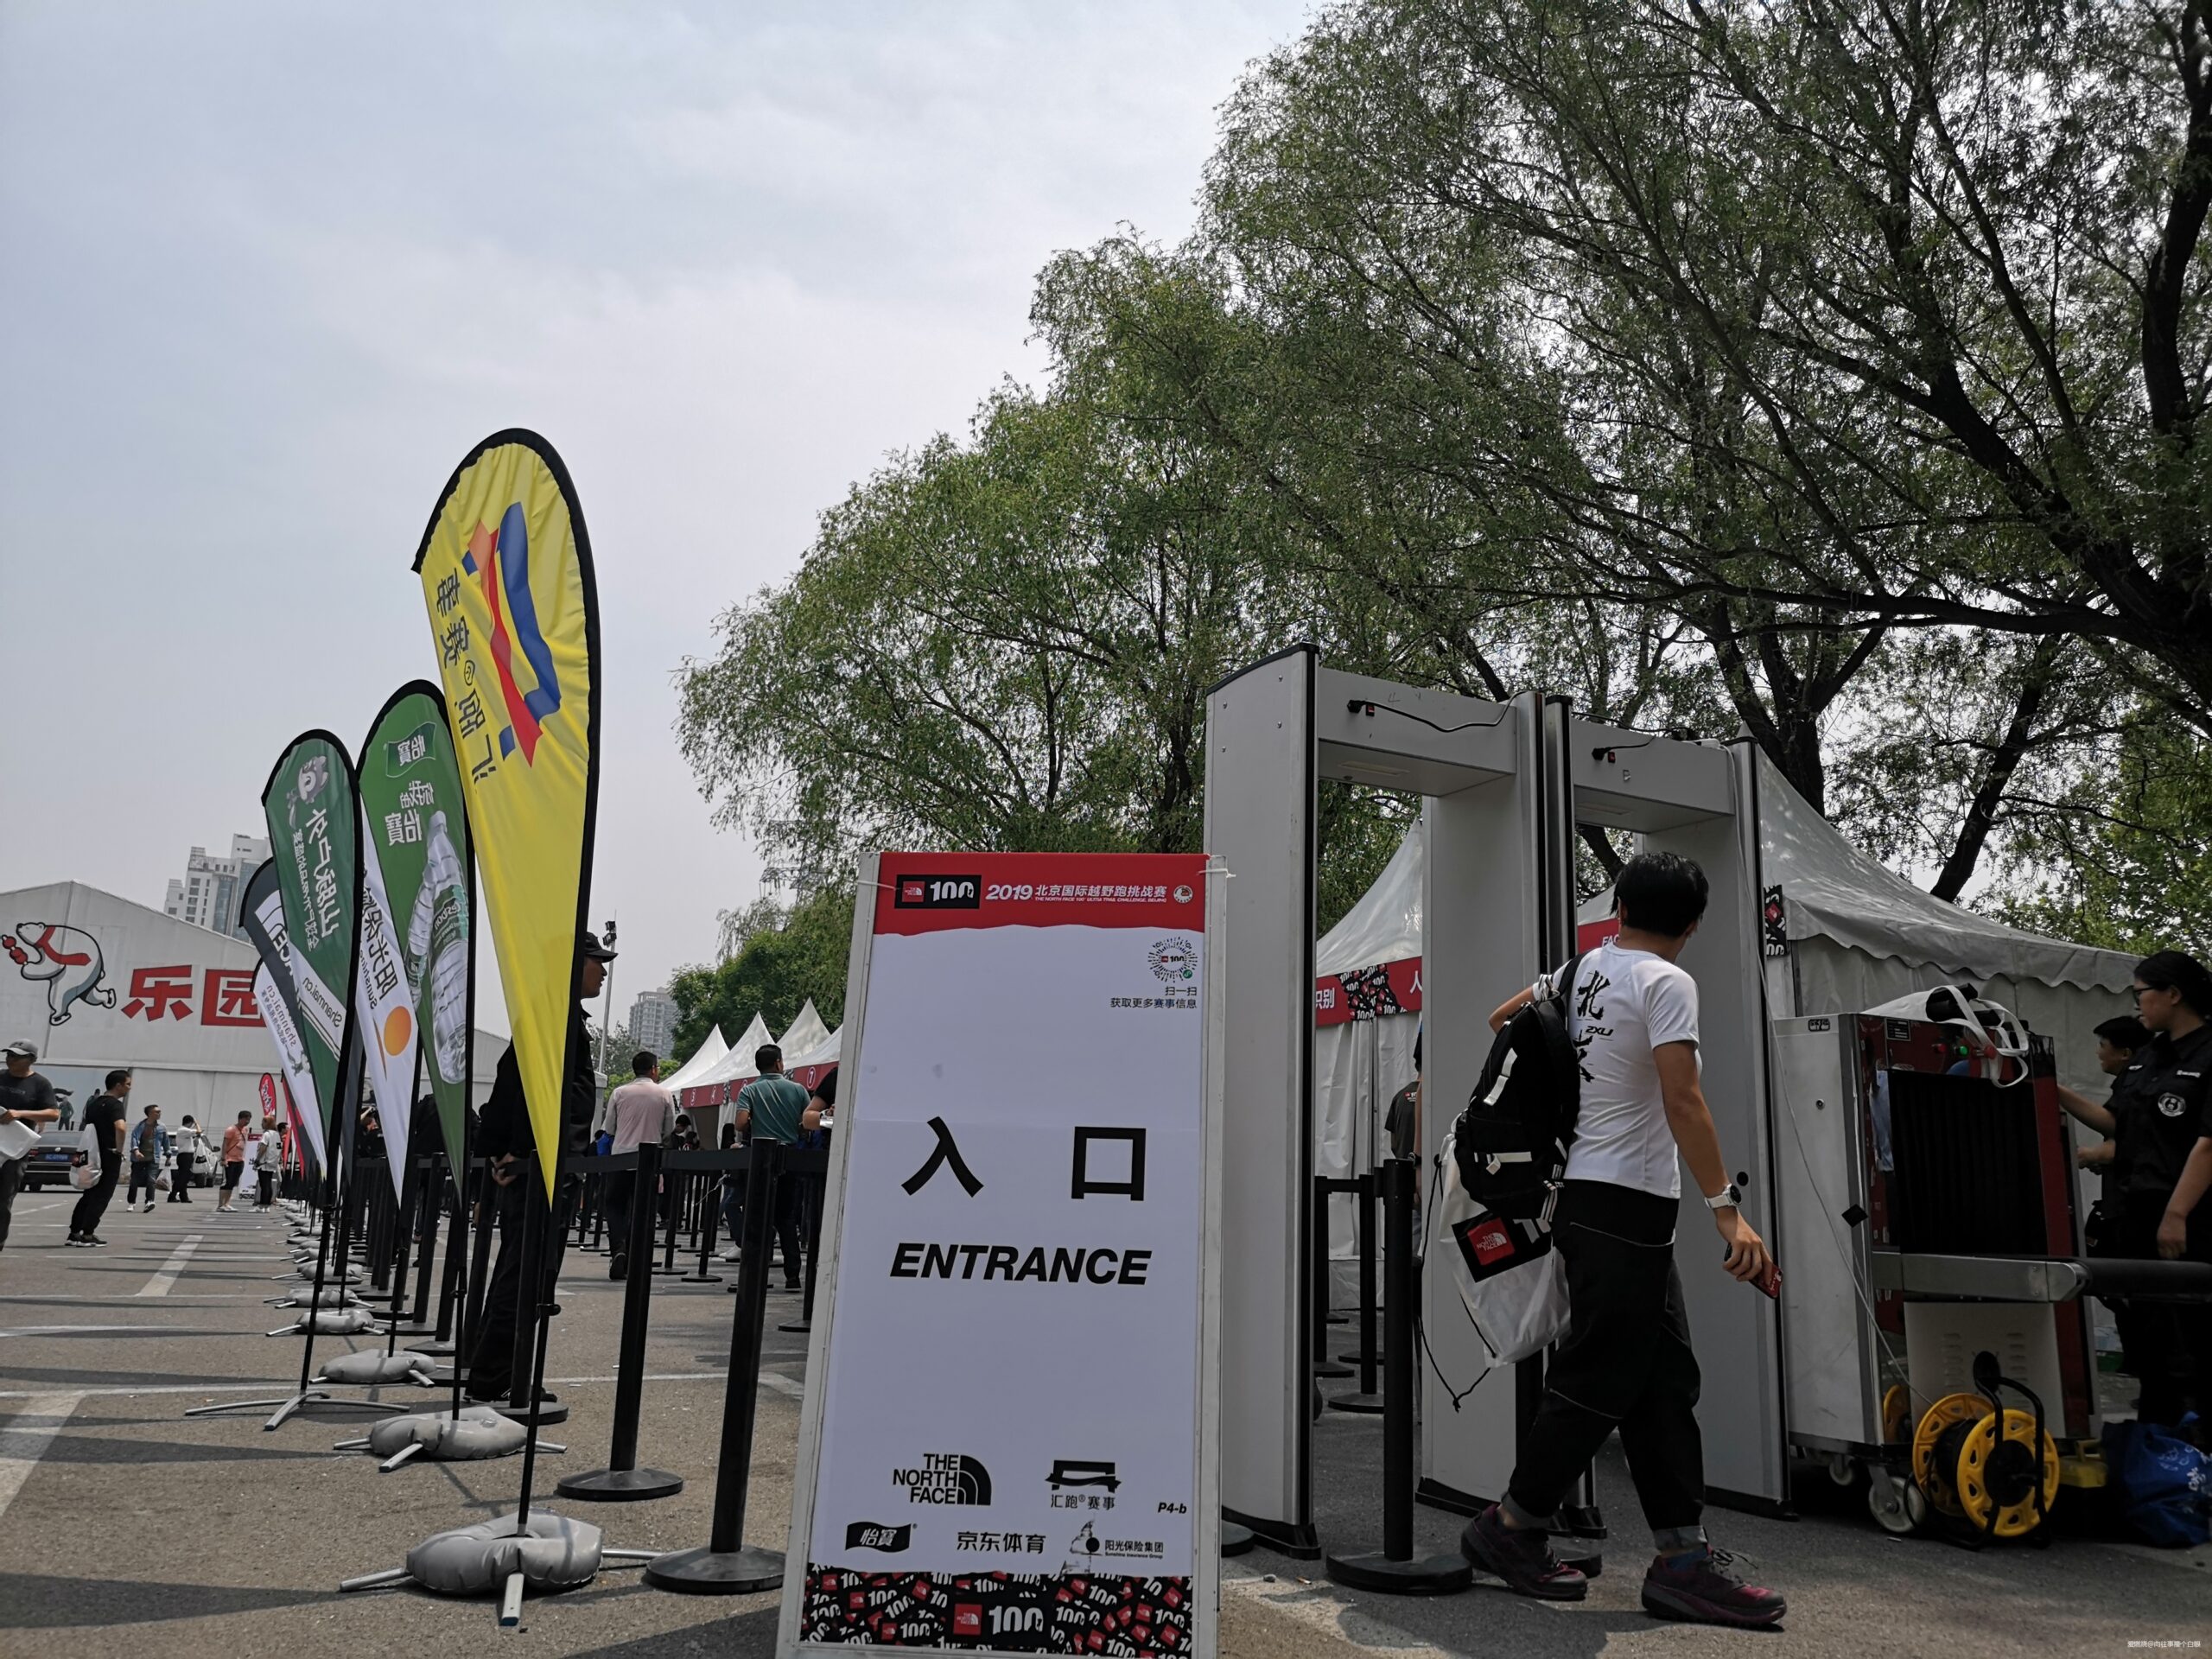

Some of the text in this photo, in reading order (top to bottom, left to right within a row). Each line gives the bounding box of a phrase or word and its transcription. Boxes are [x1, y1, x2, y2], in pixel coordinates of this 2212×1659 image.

[986, 884, 1033, 900] 2019
[1035, 884, 1166, 898] 北京国际越野跑挑战赛
[121, 964, 268, 1027] 乐园
[1165, 986, 1197, 996] 扫一扫
[1110, 997, 1197, 1008] 获取更多赛事信息
[1586, 1026, 1614, 1037] 2XU
[901, 1116, 1146, 1201] 入口
[890, 1243, 1152, 1285] ENTRANCE
[924, 1453, 958, 1471] THE
[893, 1469, 957, 1487] NORTH
[910, 1487, 957, 1504] FACE
[1157, 1502, 1187, 1514] P4-b
[957, 1531, 1046, 1554] 京东体育
[1104, 1540, 1163, 1553] 阳光保险集团
[988, 1605, 1043, 1635] 100
